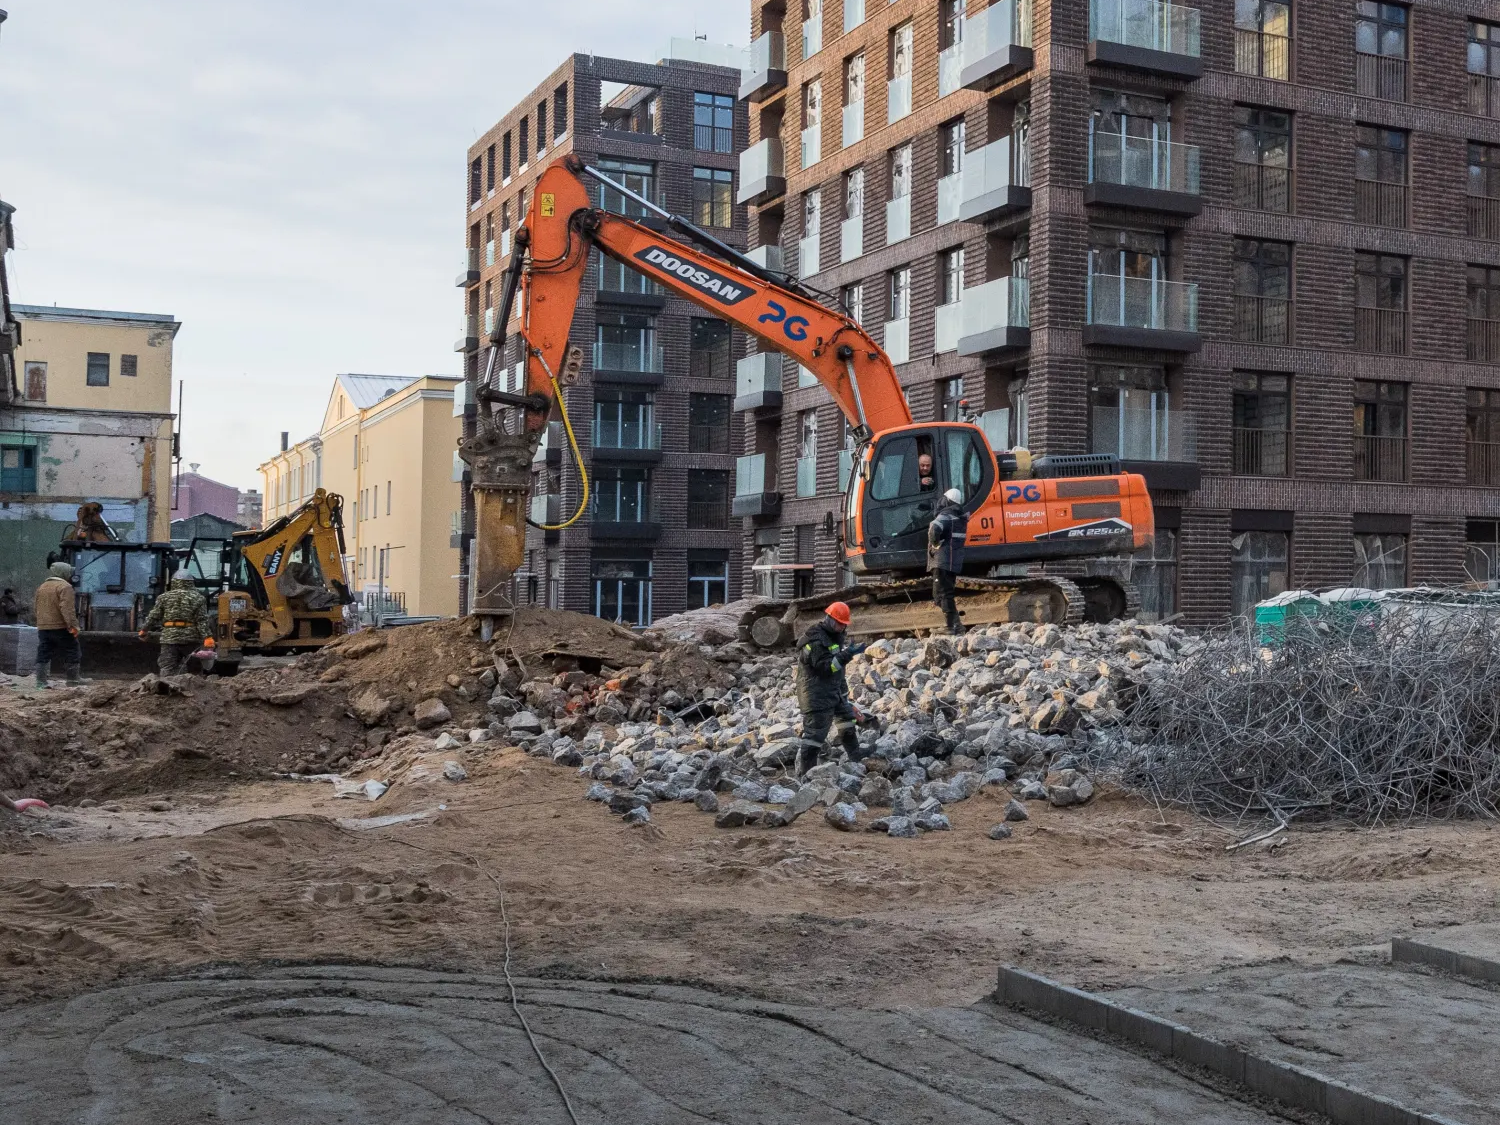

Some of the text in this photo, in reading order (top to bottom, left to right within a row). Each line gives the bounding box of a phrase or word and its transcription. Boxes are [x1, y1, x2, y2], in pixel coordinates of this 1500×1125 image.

[645, 249, 742, 301] DOOSAN
[757, 300, 810, 341] PG
[1006, 484, 1041, 503] PG
[981, 517, 994, 529] 01
[269, 550, 282, 574] SANY
